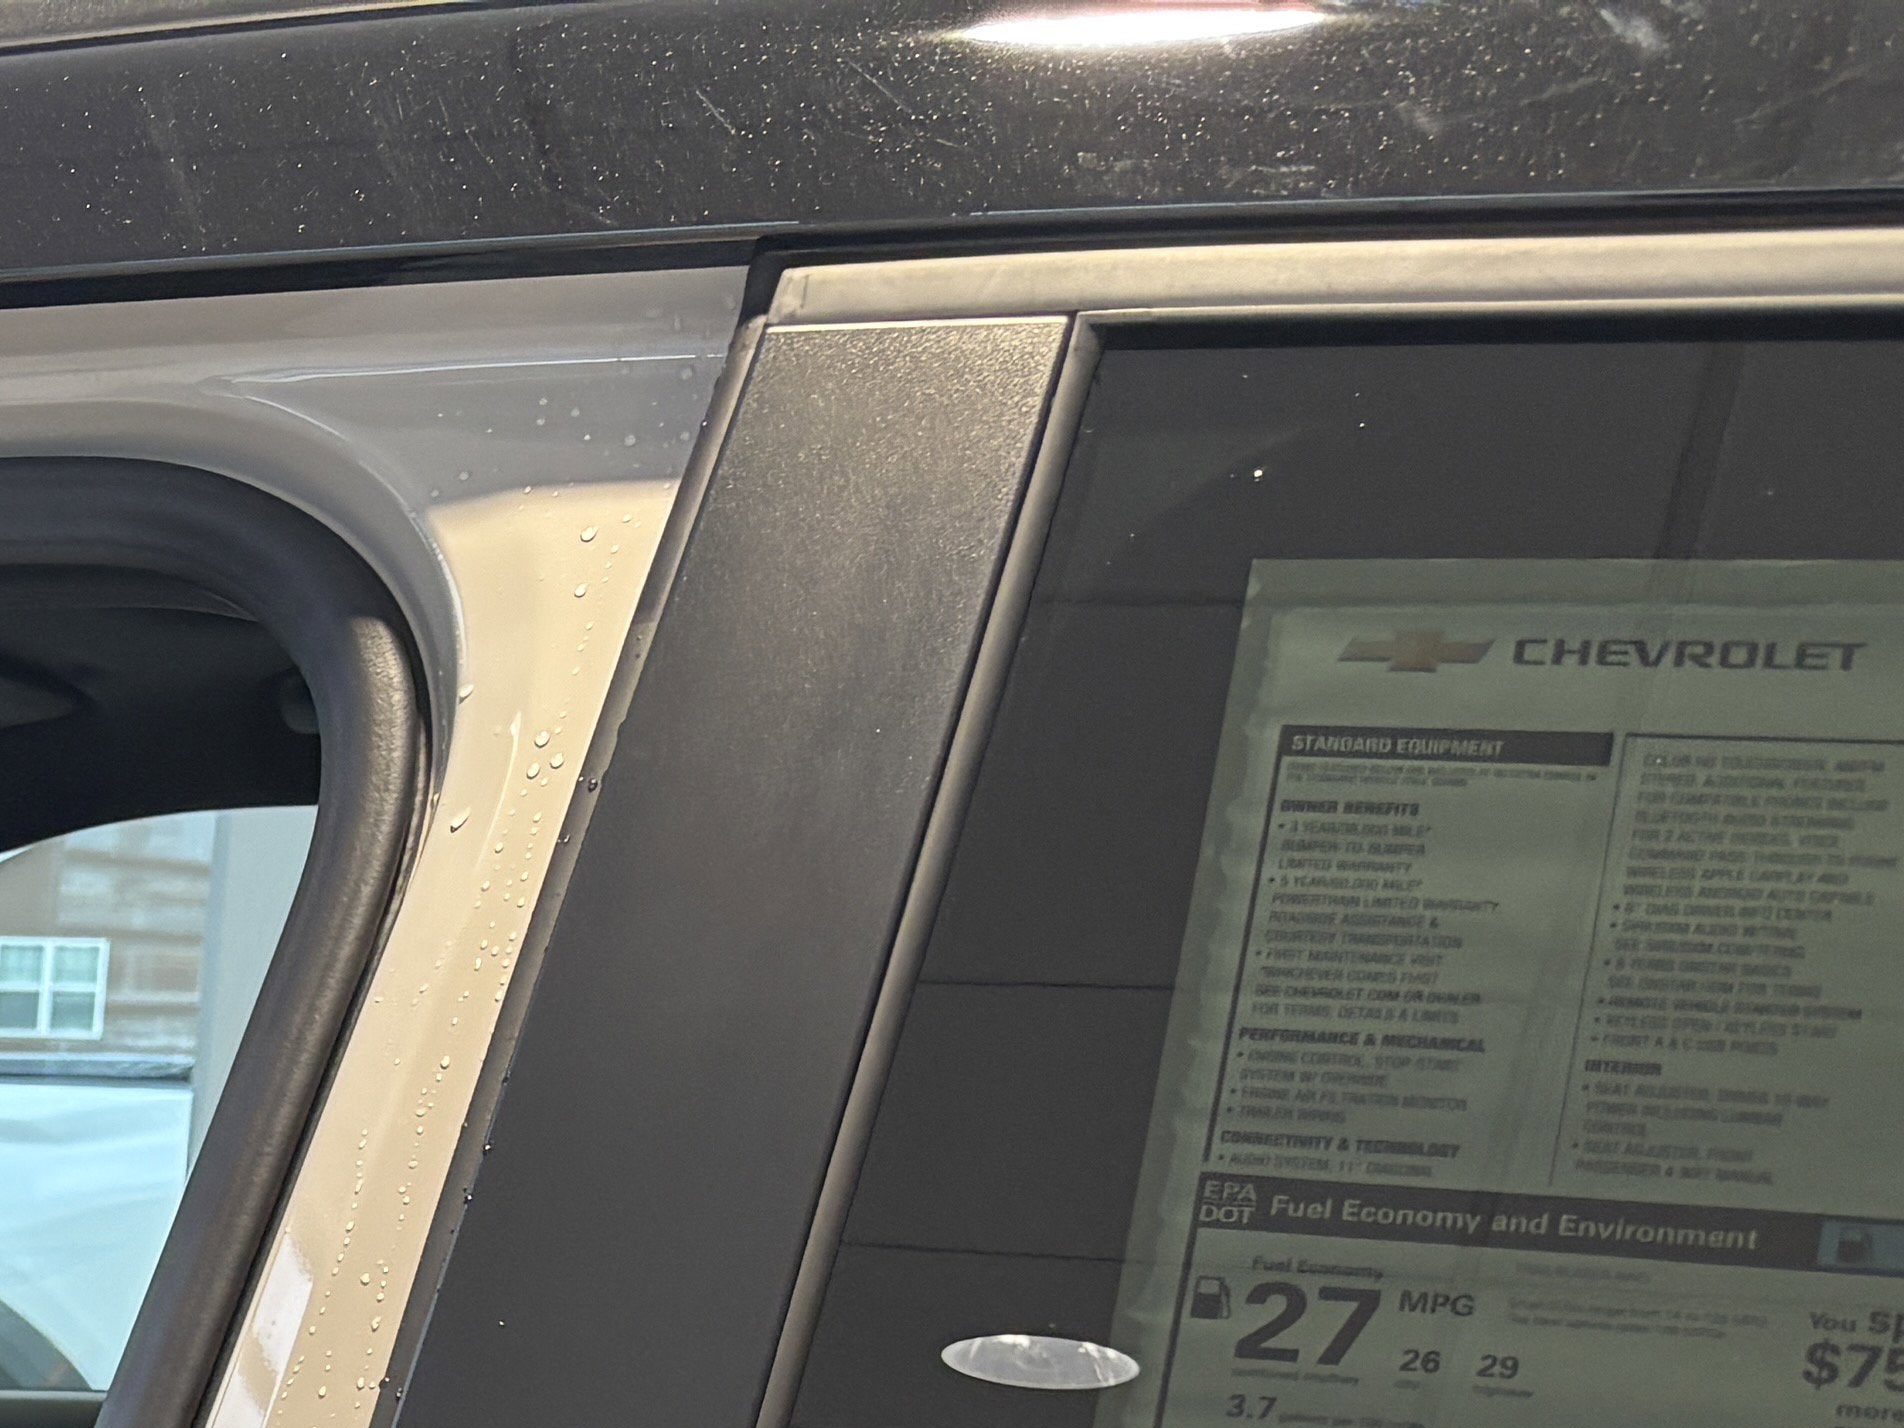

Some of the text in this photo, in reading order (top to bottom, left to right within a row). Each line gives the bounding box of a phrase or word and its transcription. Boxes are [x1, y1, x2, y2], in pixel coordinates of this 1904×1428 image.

[1512, 637, 1868, 671] CHEVROLET
[1292, 735, 1504, 757] STANDARD EQUIPMENT
[1204, 1181, 1257, 1201] EPA
[1199, 1205, 1256, 1225] DOT
[1270, 1195, 1758, 1250] Fuel Economy and Environment
[1252, 1255, 1384, 1282] Fuel Economy
[1234, 1281, 1475, 1367] 27 MPG
[1809, 1311, 1857, 1333] You
[1399, 1349, 1441, 1374] 26
[1476, 1354, 1520, 1380] 29
[1226, 1393, 1277, 1420] 3.7
